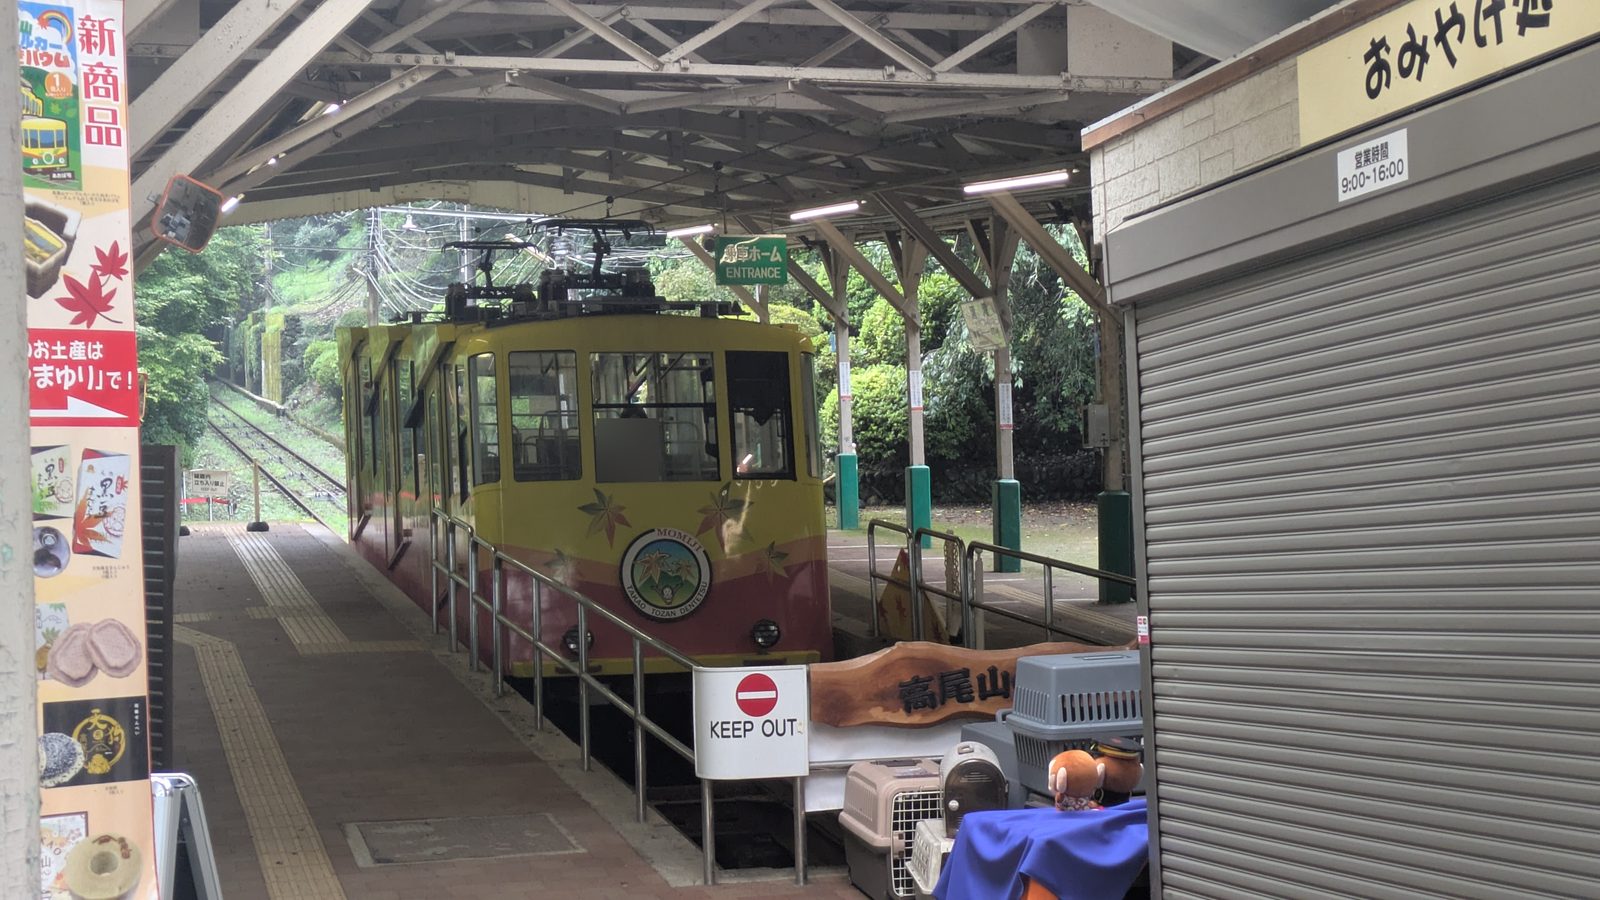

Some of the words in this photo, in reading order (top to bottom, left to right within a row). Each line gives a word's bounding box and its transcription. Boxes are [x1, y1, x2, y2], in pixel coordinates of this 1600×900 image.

[78, 15, 122, 147] 新商品
[1355, 141, 1389, 169] 営業時間
[726, 267, 781, 279] ENTRANCE
[28, 340, 104, 360] お土産は
[657, 528, 700, 551] MOMIJI
[627, 585, 646, 609] TAKAO
[651, 608, 676, 617] TOZAN
[680, 581, 707, 614] DENTETSU
[898, 665, 1015, 714] 高尾山
[710, 720, 754, 739] KEEP
[761, 718, 797, 738] OUT
